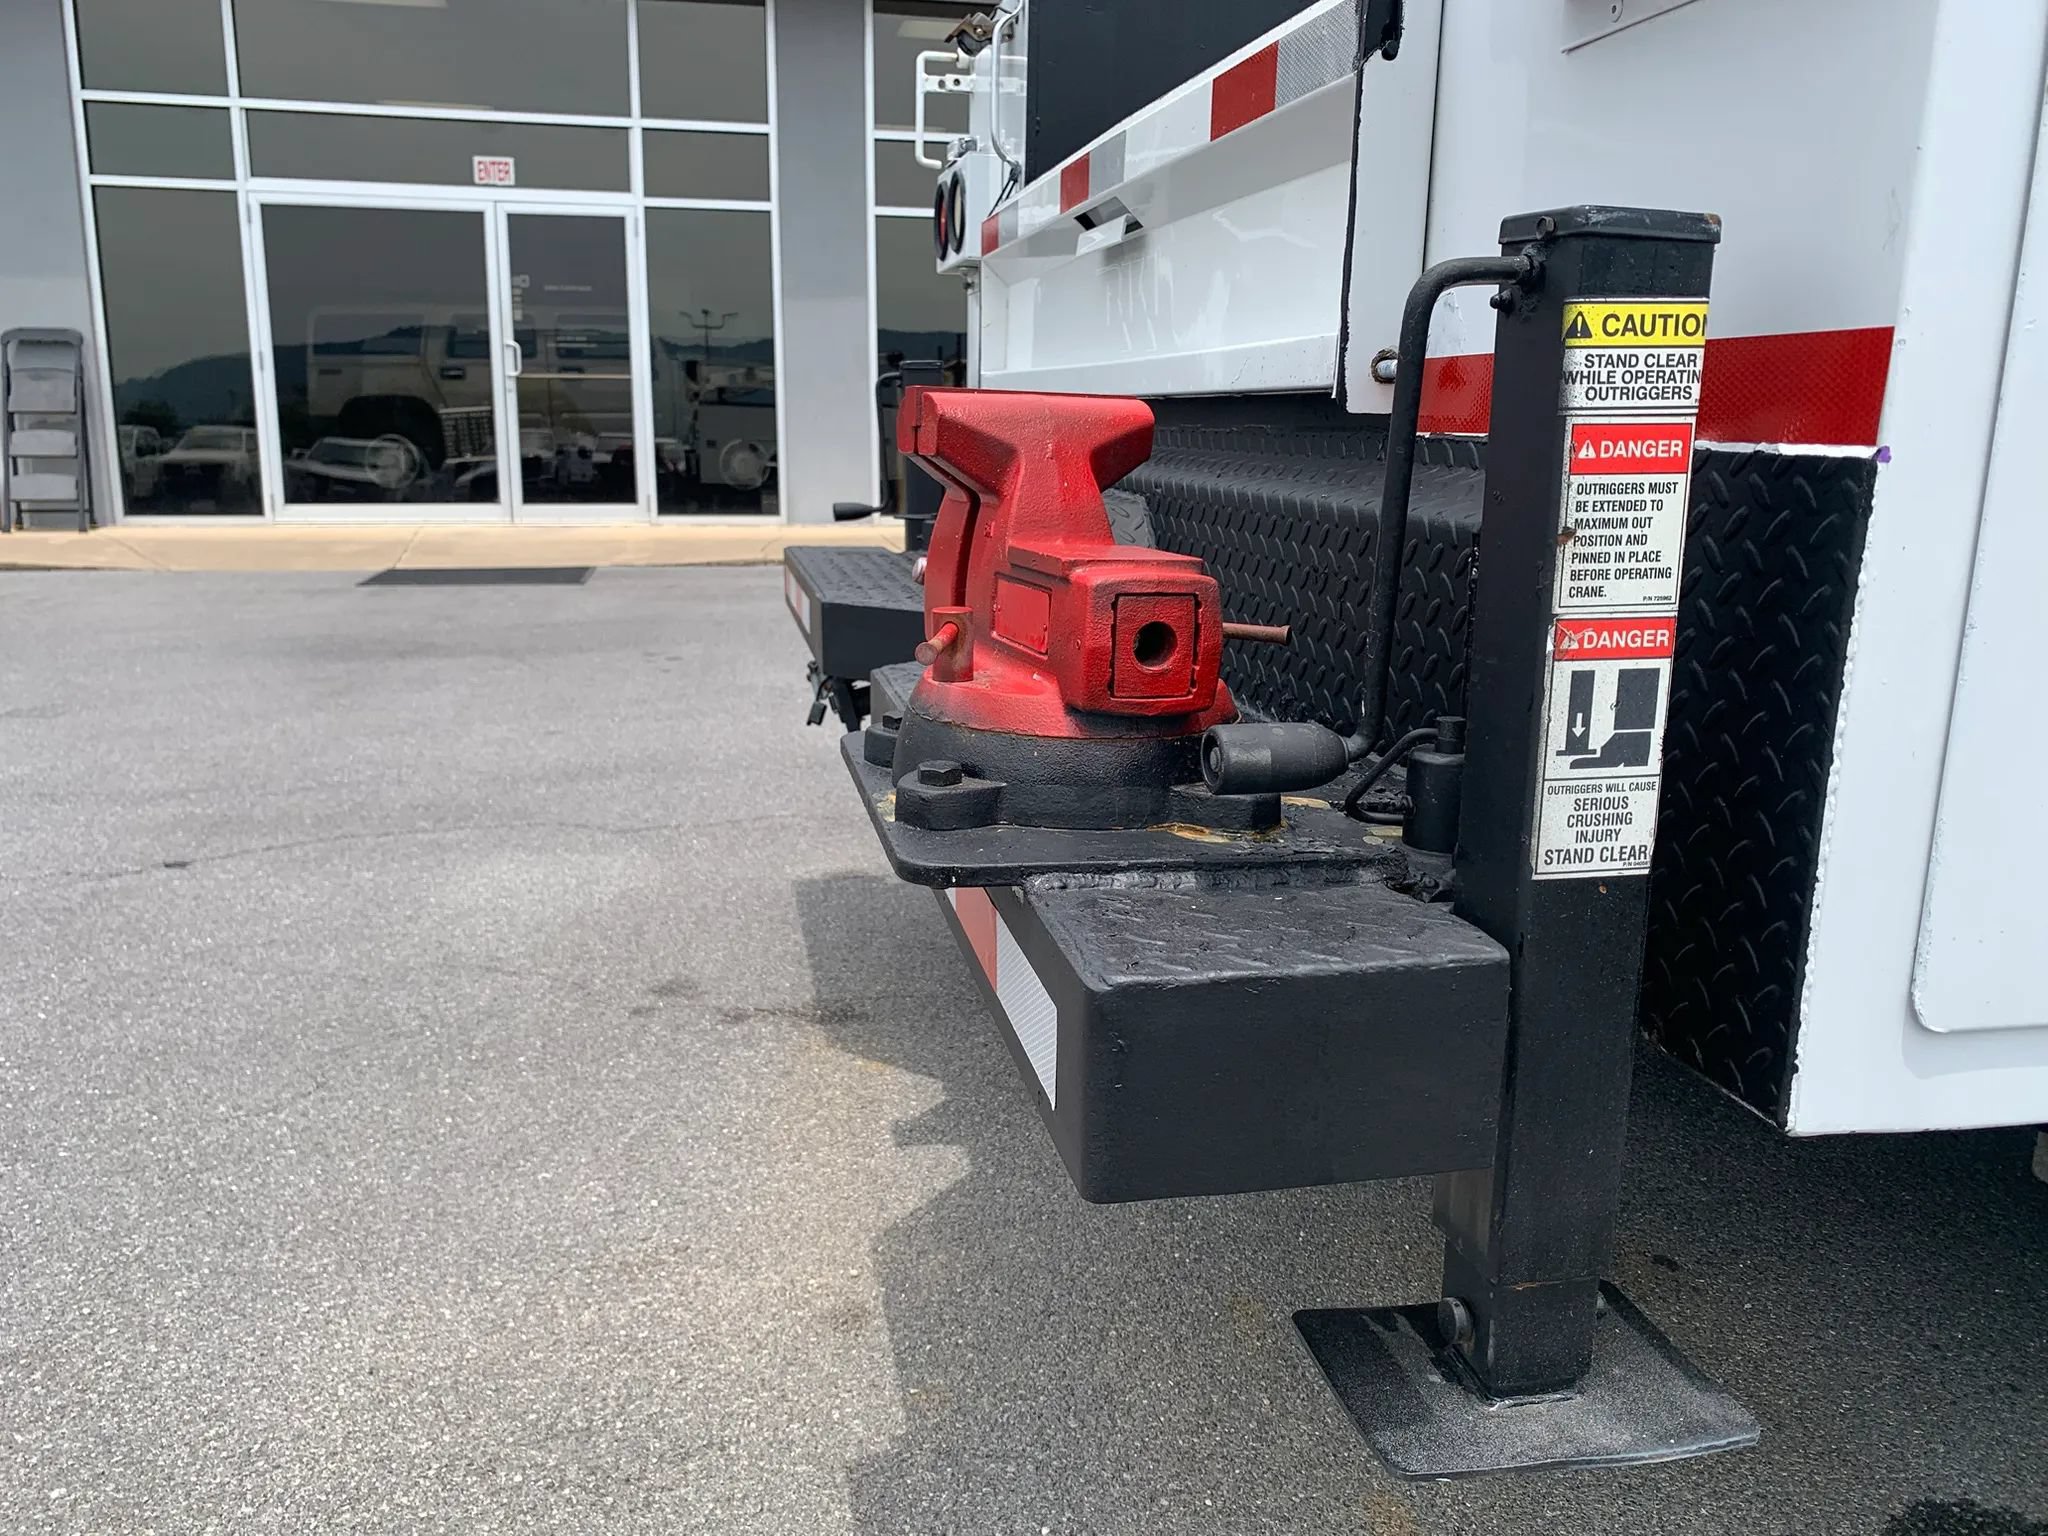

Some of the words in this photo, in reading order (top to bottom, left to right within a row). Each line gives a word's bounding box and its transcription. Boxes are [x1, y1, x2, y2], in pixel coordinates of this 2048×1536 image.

[477, 160, 510, 181] ENTER
[1584, 353, 1639, 369] STAND
[1644, 353, 1698, 368] CLEAR
[1563, 370, 1617, 385] WHILE
[1621, 369, 1701, 385] OPERATIN
[1585, 385, 1693, 401] OUTRIGGERS
[1600, 440, 1684, 458] DANGER
[1577, 482, 1645, 495] OUTRIGGERS
[1648, 481, 1679, 494] MUST
[1575, 500, 1589, 513] BE
[1592, 499, 1647, 512] EXTENDED
[1651, 499, 1664, 511] TO
[1574, 517, 1628, 530] MAXIMUM
[1631, 516, 1654, 529] OUT
[1573, 534, 1623, 547] POSITION
[1625, 533, 1648, 546] AND
[1571, 552, 1611, 564] PINNED
[1614, 551, 1625, 563] IN
[1628, 550, 1662, 563] PLACE
[1570, 569, 1611, 582] BEFORE
[1614, 566, 1672, 580] OPERATING
[1568, 585, 1607, 598] CRANE.
[1583, 629, 1669, 649] DANGER
[1547, 783, 1603, 795] OUTRIGGERS
[1605, 782, 1626, 793] WILL
[1629, 781, 1657, 792] CAUSE
[1573, 796, 1629, 812] SERIOUS
[1567, 811, 1633, 828] CRUSHING
[1575, 828, 1622, 843] INJURY
[1544, 847, 1594, 866] STAND
[1600, 844, 1648, 863] CLEAR
